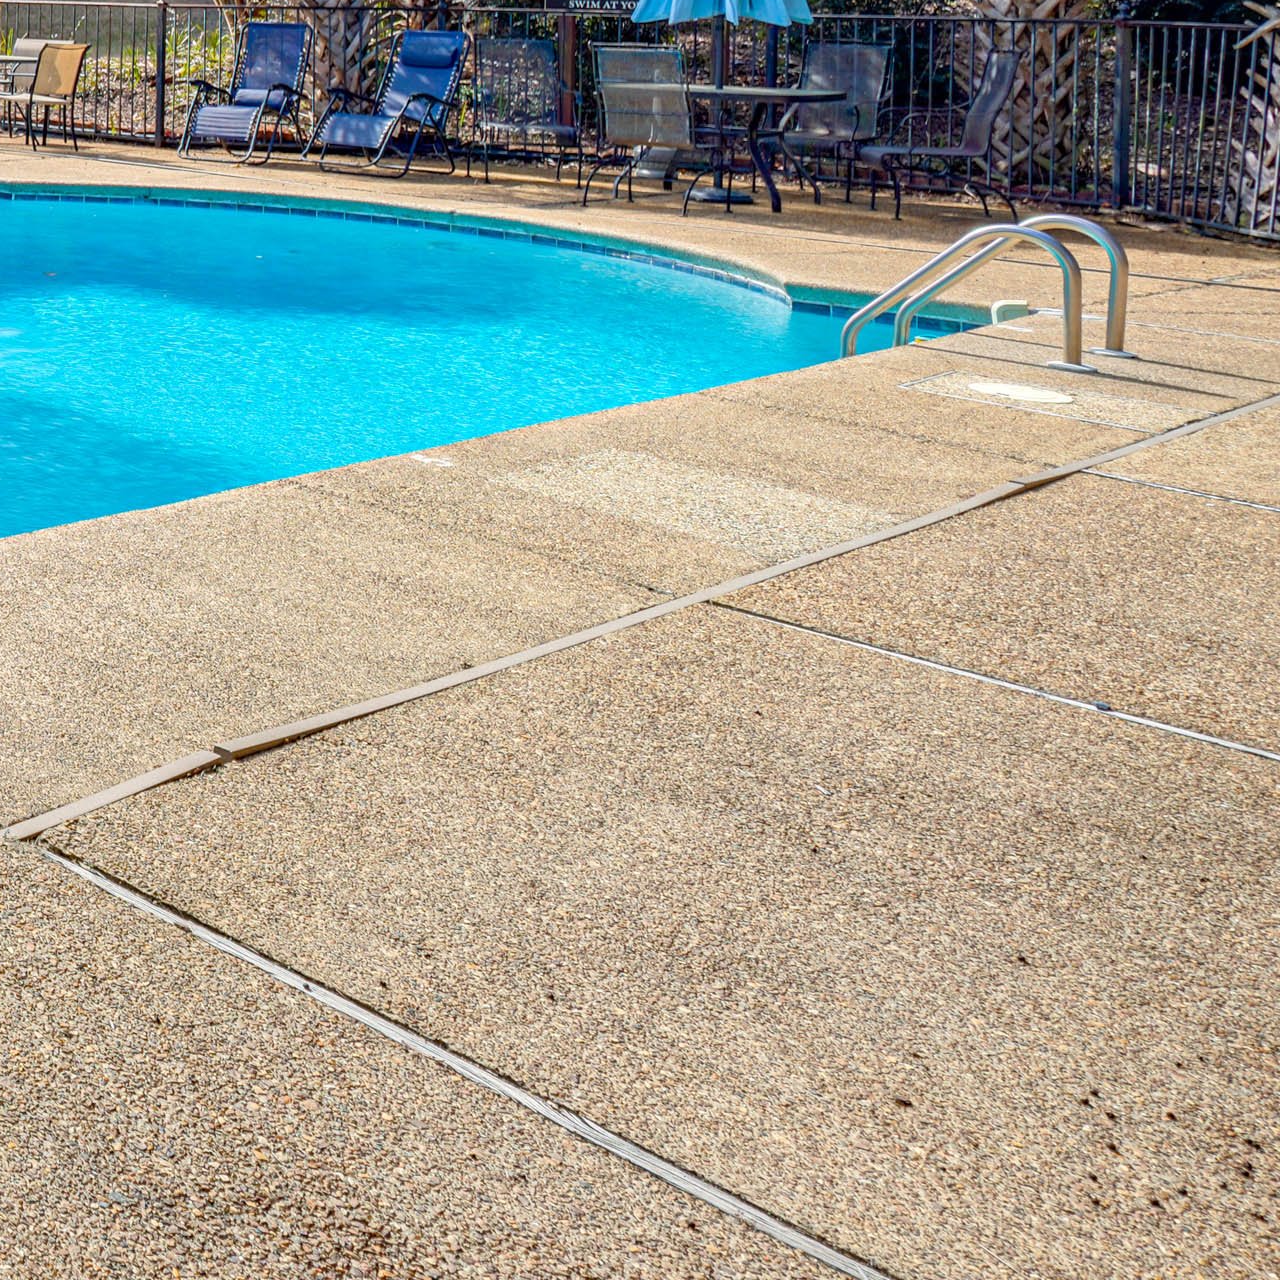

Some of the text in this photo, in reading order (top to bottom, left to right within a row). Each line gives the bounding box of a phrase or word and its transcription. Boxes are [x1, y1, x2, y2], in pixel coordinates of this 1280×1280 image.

[568, 0, 638, 9] SWIM AT YO
